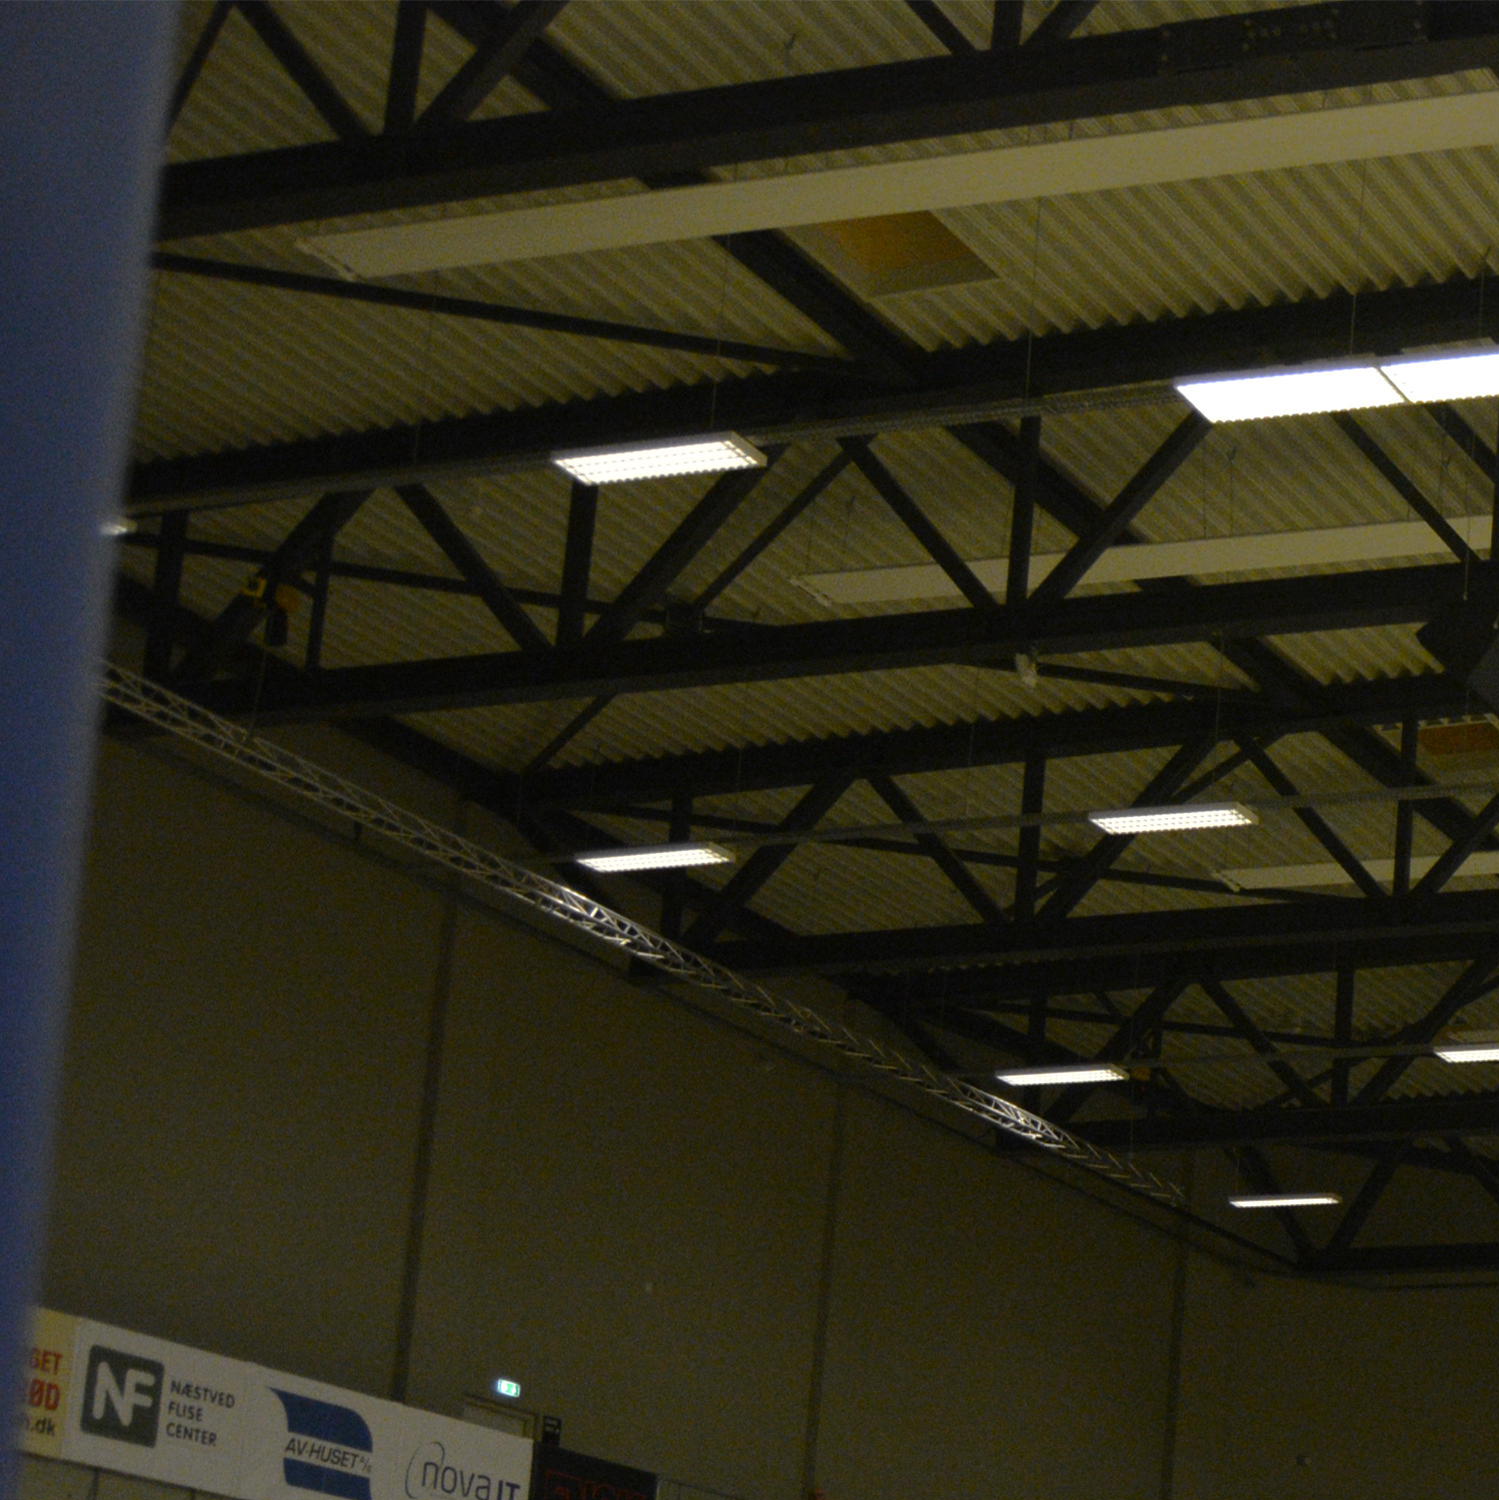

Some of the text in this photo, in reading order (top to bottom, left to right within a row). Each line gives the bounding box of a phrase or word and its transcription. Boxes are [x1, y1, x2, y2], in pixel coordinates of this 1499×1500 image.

[170, 1379, 236, 1409] NÆSTVED
[168, 1402, 203, 1422] FLISE
[166, 1422, 217, 1447] CENTER
